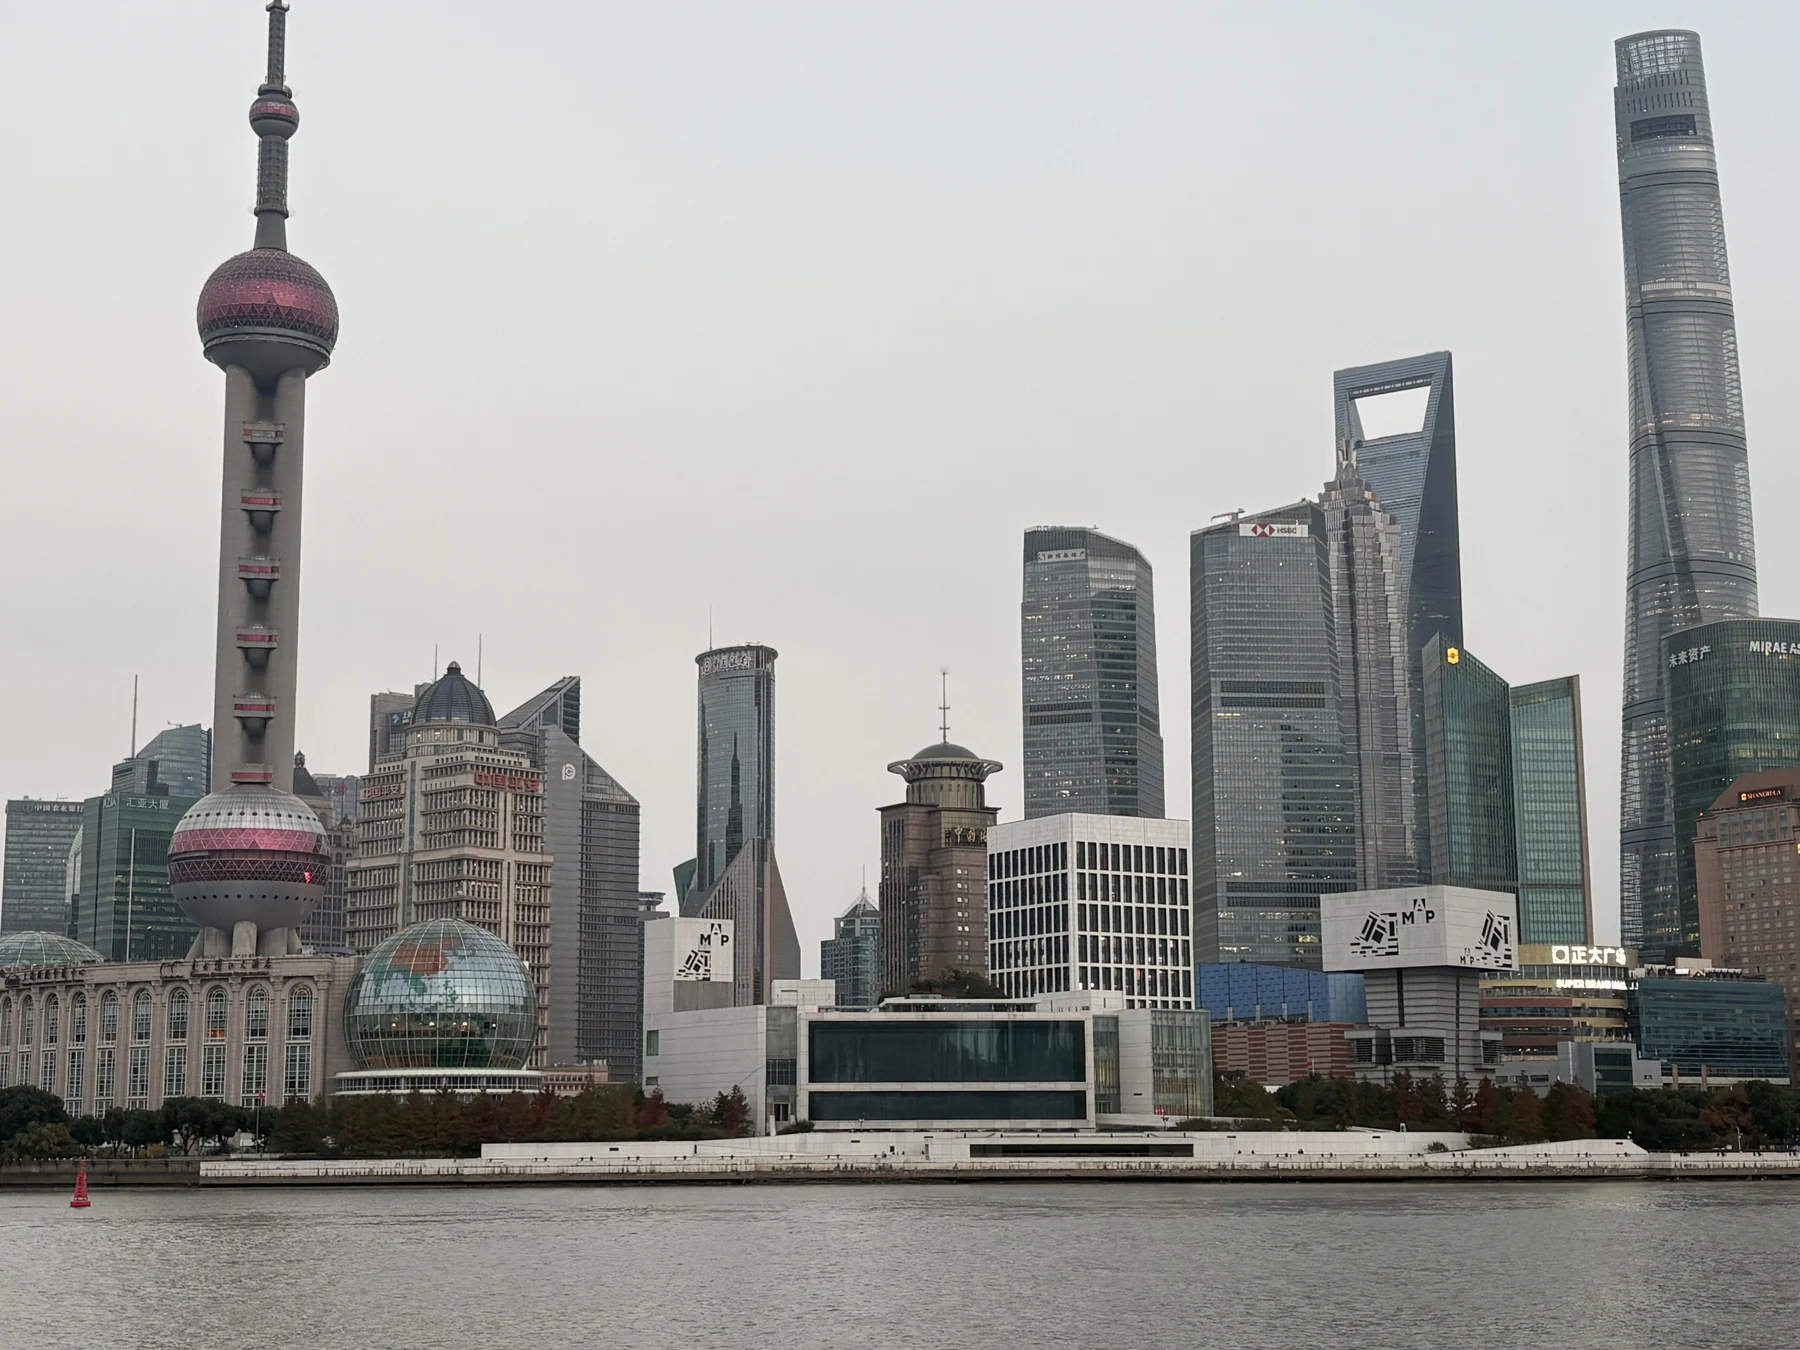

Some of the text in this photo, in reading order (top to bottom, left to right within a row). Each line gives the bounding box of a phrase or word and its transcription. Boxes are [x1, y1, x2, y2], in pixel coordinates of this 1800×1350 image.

[1749, 641, 1787, 653] MIRAE
[1669, 645, 1711, 668] 未来资产
[475, 772, 540, 793] 中国平安
[363, 784, 401, 799] 中国平安
[34, 804, 84, 812] 中国农业银行
[126, 797, 169, 809] 汇亚大厦
[1402, 898, 1435, 924] MAP
[700, 923, 729, 946] MAP
[1571, 946, 1626, 965] 正大广场
[1556, 979, 1584, 988] SUPER
[1585, 980, 1611, 989] BRAND
